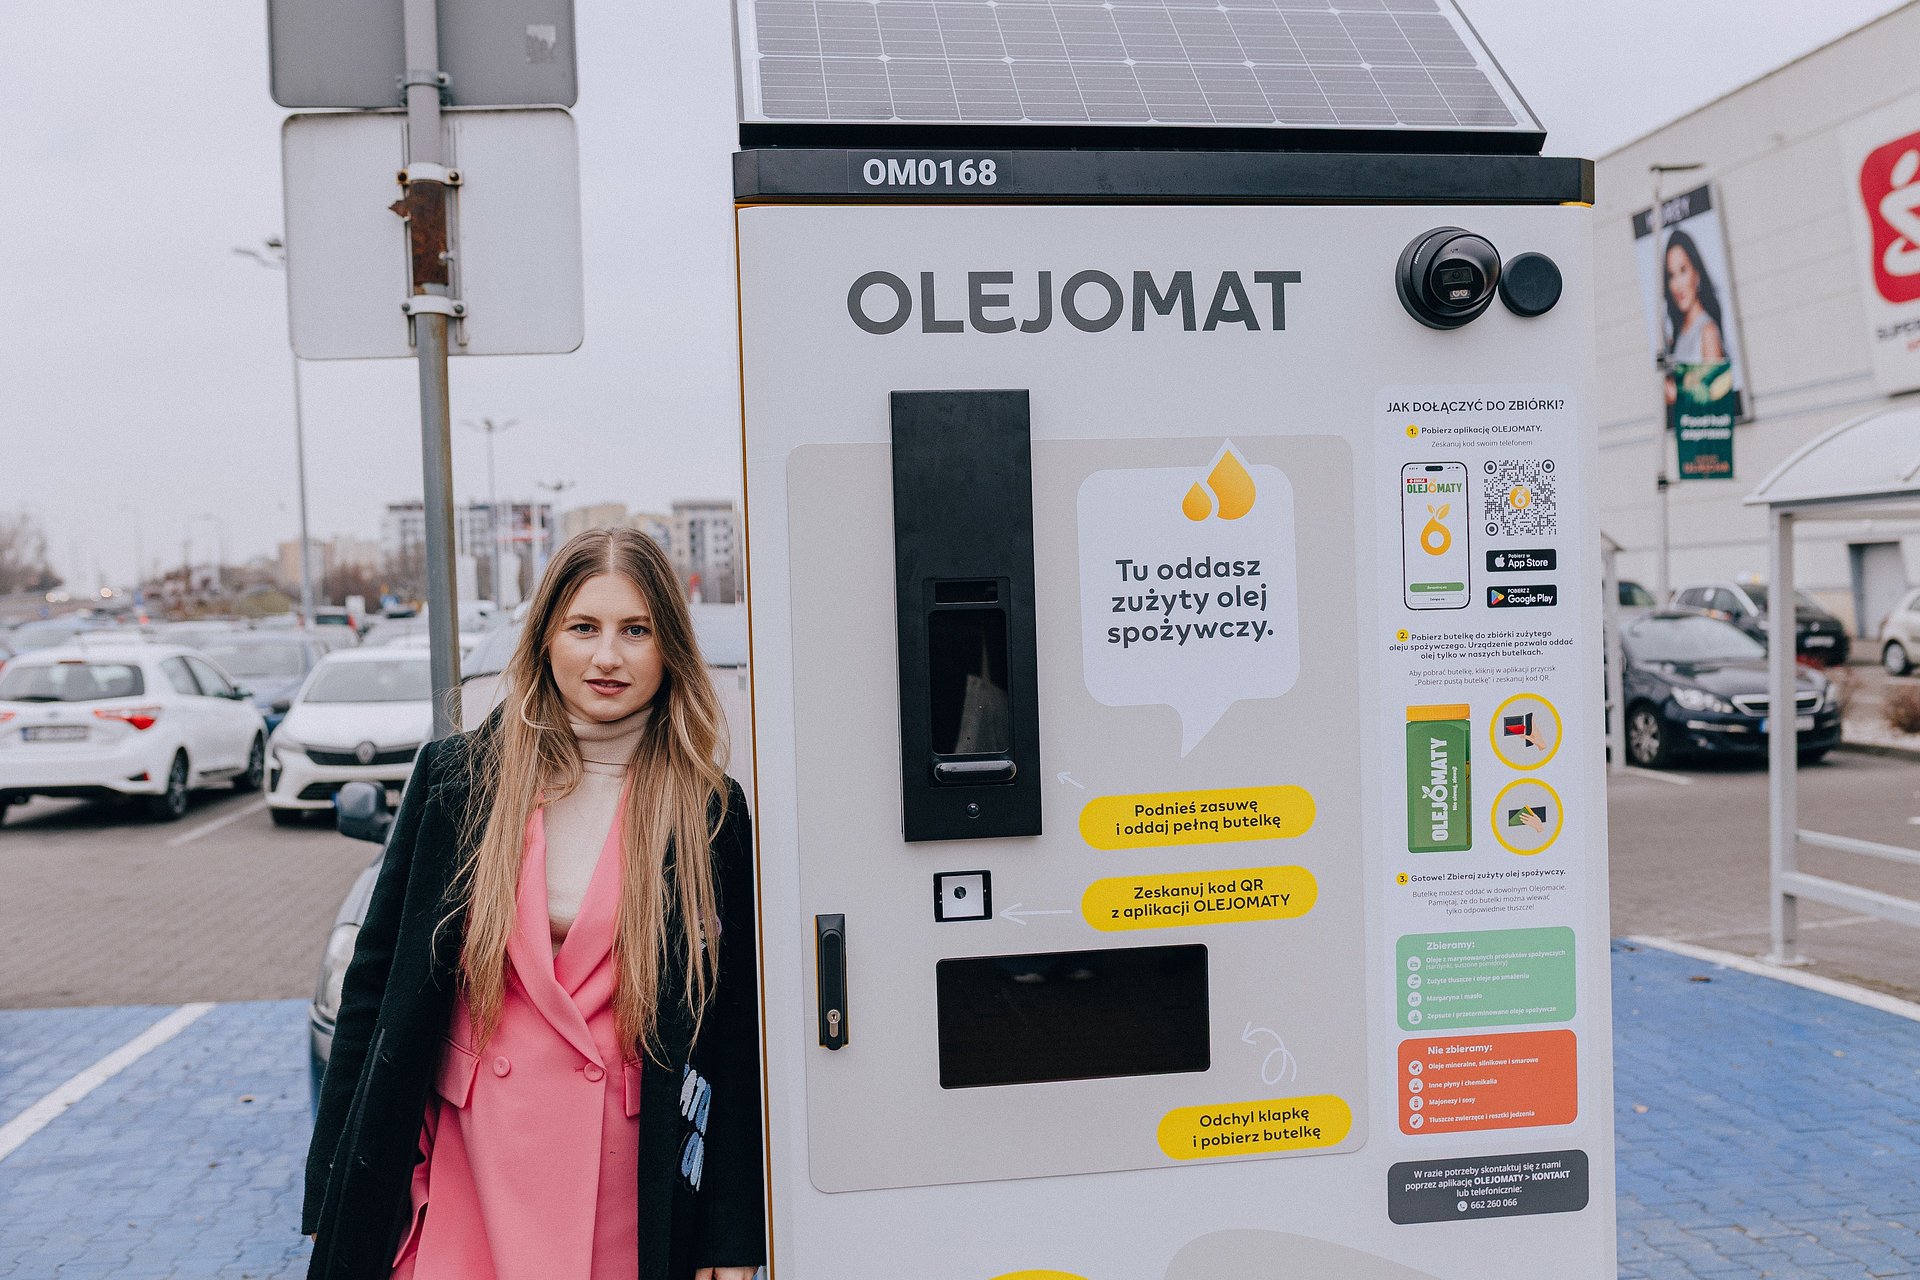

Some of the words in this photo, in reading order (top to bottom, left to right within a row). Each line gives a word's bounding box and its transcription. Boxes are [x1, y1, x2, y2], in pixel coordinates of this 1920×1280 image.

[863, 157, 997, 187] OM0168
[847, 269, 1302, 335] OLEJOMAT
[1387, 402, 1410, 413] JAK
[1413, 399, 1483, 414] DOŁĄCZYĆ
[1487, 401, 1505, 411] DO
[1508, 398, 1564, 410] ZBIÓRKI?
[1421, 426, 1452, 435] Pobierz
[1453, 426, 1490, 435] aplikację
[1491, 425, 1543, 433] OLEJOMATY.
[1431, 440, 1462, 449] Zeskanuj
[1499, 439, 1533, 447] telefonem
[1407, 481, 1462, 494] OLEJOMATY
[1115, 559, 1148, 582] Tu
[1157, 556, 1261, 581] oddasz
[1508, 559, 1525, 569] App
[1526, 558, 1548, 567] Store
[1112, 588, 1209, 616] zużyty
[1217, 583, 1267, 611] olej
[1508, 594, 1536, 605] Google
[1537, 594, 1553, 604] Play
[1107, 617, 1274, 649] spożywczy.
[1443, 632, 1474, 641] butelkę
[1487, 631, 1514, 639] zbiórki
[1516, 630, 1552, 639] zużytego
[1389, 644, 1409, 652] oleju
[1410, 643, 1466, 651] spożywczego.
[1468, 641, 1512, 650] Urządzenie
[1514, 640, 1547, 648] pozwala
[1549, 638, 1573, 646] oddać
[1421, 652, 1435, 660] olej
[1436, 651, 1458, 660] tylko
[1468, 650, 1500, 659] naszych
[1502, 648, 1543, 657] butelkach.
[1409, 669, 1422, 677] Aby
[1423, 668, 1446, 677] pobrać
[1475, 667, 1495, 675] kliknij
[1502, 666, 1529, 675] aplikacji
[1530, 665, 1556, 674] przycisk
[1444, 679, 1463, 687] pustą
[1496, 676, 1524, 684] zeskanuj
[1430, 737, 1449, 842] OLEJOMATY
[1134, 801, 1197, 819] Podnieś
[1200, 798, 1259, 816] zasuwę
[1115, 823, 1121, 836] i
[1124, 818, 1169, 837] oddaj
[1173, 816, 1220, 834] pełną
[1223, 812, 1281, 831] butelkę
[1411, 874, 1445, 882] Gotowe!
[1447, 873, 1476, 881] Zbieraj
[1477, 871, 1503, 880] zużyty
[1505, 870, 1519, 879] olej
[1521, 869, 1566, 878] spożywczy.
[1134, 884, 1204, 902] Zeskanuj
[1208, 880, 1238, 895] kod
[1240, 878, 1264, 893] QR
[1412, 890, 1438, 898] Butelkę
[1465, 887, 1485, 895] oddać
[1493, 886, 1527, 894] dowolnym
[1428, 898, 1458, 907] Pamiętaj,
[1460, 897, 1468, 905] że
[1469, 897, 1478, 905] do
[1479, 896, 1501, 904] butelki
[1526, 893, 1550, 901] wlewać
[1111, 910, 1120, 919] z
[1123, 900, 1190, 921] aplikacji
[1193, 893, 1290, 914] OLEJOMATY
[1446, 907, 1462, 915] tylko
[1463, 905, 1505, 914] odpowiednie
[1507, 904, 1534, 912] tłuszcze!
[1426, 941, 1475, 951] Zbieramy:
[1426, 956, 1442, 964] Oleje
[1476, 975, 1491, 983] oleje
[1492, 975, 1500, 983] po
[1428, 1046, 1443, 1055] Nie
[1445, 1044, 1493, 1054] zbieramy:
[1479, 1058, 1507, 1066] silnikowe
[1511, 1056, 1539, 1064] smarowe
[1443, 1080, 1460, 1089] płyny
[1464, 1078, 1498, 1086] chemikalia
[1428, 1097, 1458, 1106] Majonezy
[1462, 1097, 1476, 1105] sosy
[1199, 1111, 1255, 1127] Odchyl
[1258, 1107, 1310, 1123] klapkę
[1428, 1115, 1455, 1123] Tłuszcze
[1455, 1114, 1485, 1122] zwierzęce
[1488, 1111, 1510, 1120] resztki
[1510, 1110, 1535, 1120] jedzenia
[1193, 1135, 1197, 1147] i
[1201, 1132, 1260, 1149] pobierz
[1263, 1126, 1321, 1141] butelkę
[1413, 1170, 1422, 1178] W
[1424, 1169, 1443, 1178] razie
[1444, 1166, 1480, 1178] potrzeby
[1480, 1163, 1522, 1174] skontaktuj
[1523, 1162, 1534, 1172] się
[1541, 1160, 1561, 1169] nami
[1405, 1180, 1437, 1192] poprzez
[1438, 1177, 1473, 1189] aplikację
[1474, 1174, 1524, 1186] OLEJOMATY
[1531, 1170, 1571, 1181] KONTAKT
[1456, 1188, 1470, 1197] lub
[1470, 1185, 1523, 1196] telefonicznie:
[1470, 1200, 1485, 1209] 662
[1486, 1199, 1501, 1208] 260
[1502, 1198, 1518, 1207] 066
